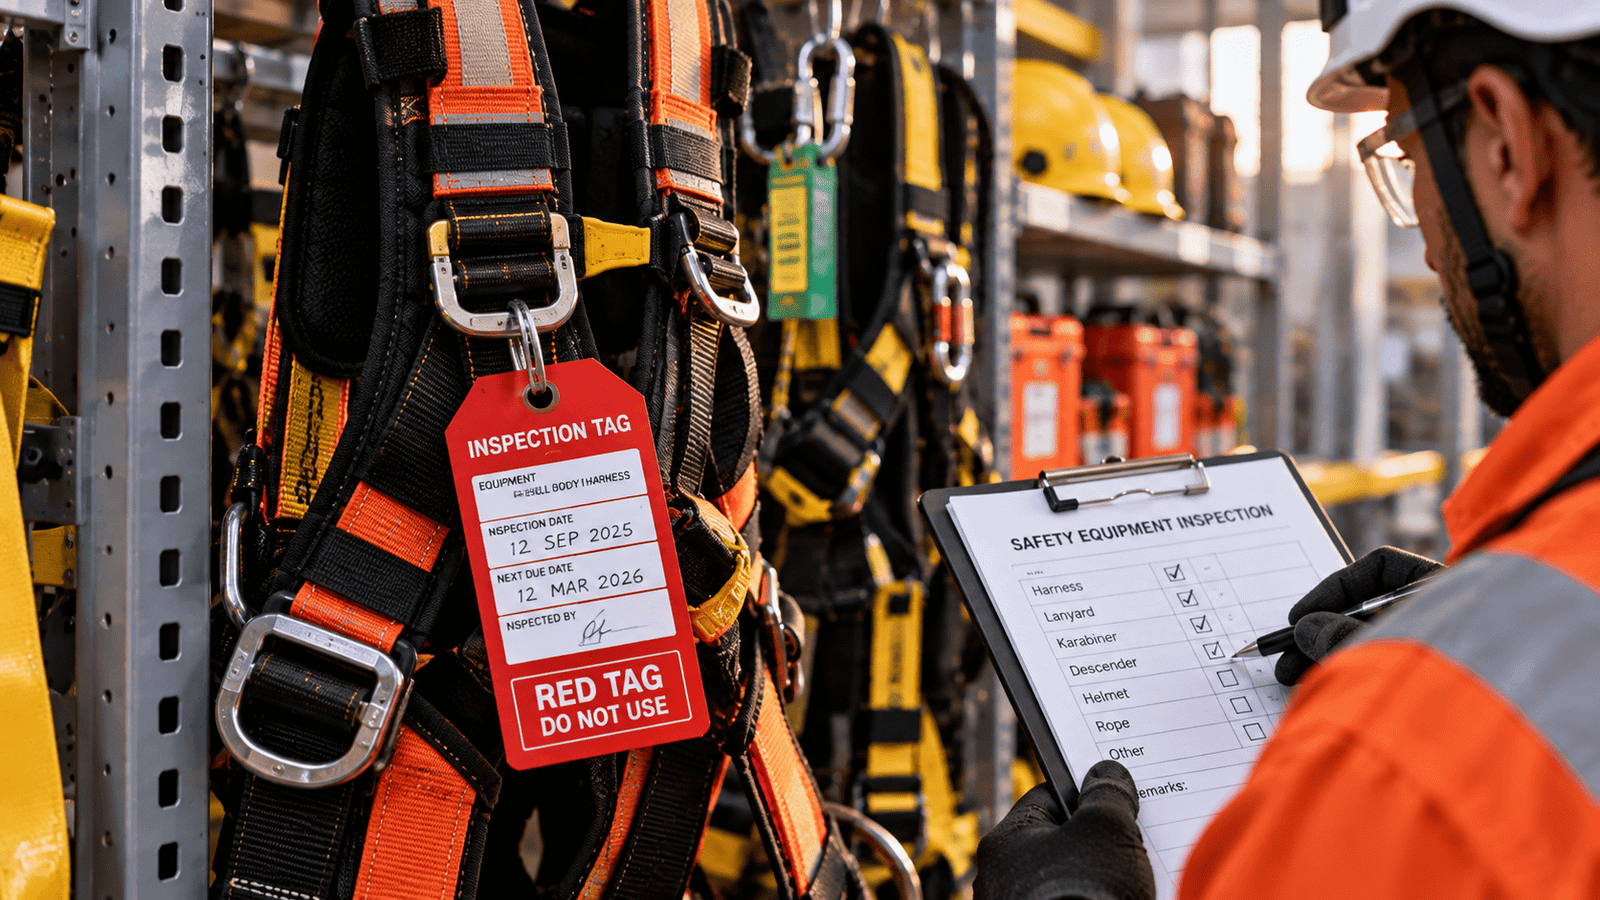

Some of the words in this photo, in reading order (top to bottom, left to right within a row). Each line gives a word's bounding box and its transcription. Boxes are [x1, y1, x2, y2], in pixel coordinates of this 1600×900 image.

[467, 424, 588, 459] INSPECTION
[590, 414, 632, 437] TAG
[478, 472, 537, 491] EQUIPMENT
[551, 480, 580, 494] BODY
[548, 514, 574, 527] DATE
[1010, 531, 1074, 551] SAFETY
[1077, 517, 1173, 543] EQUIPMENT
[1175, 504, 1274, 529] INSPECTION
[510, 539, 532, 556] 12
[544, 531, 580, 551] SEP
[589, 521, 633, 543] 2025
[496, 571, 524, 584] NEXT
[525, 566, 547, 580] DUE
[548, 562, 574, 576] DATE
[518, 586, 538, 604] 12
[550, 578, 589, 598] MAR
[597, 568, 644, 590] 2026
[1031, 580, 1084, 597] Harness
[506, 613, 561, 631] NSPECTED
[563, 610, 577, 621] BY
[1043, 606, 1096, 625] Lanyard
[1056, 631, 1118, 650] Karabiner
[1069, 656, 1138, 677] Descender
[534, 676, 597, 711] RED
[602, 663, 664, 698] TAG
[1082, 687, 1131, 705] Helmet
[540, 713, 572, 737] DO
[576, 703, 621, 730] NOT
[625, 695, 670, 721] USE
[1095, 717, 1131, 734] Rope
[1108, 744, 1146, 761] Other
[1137, 781, 1188, 799] emarks:
